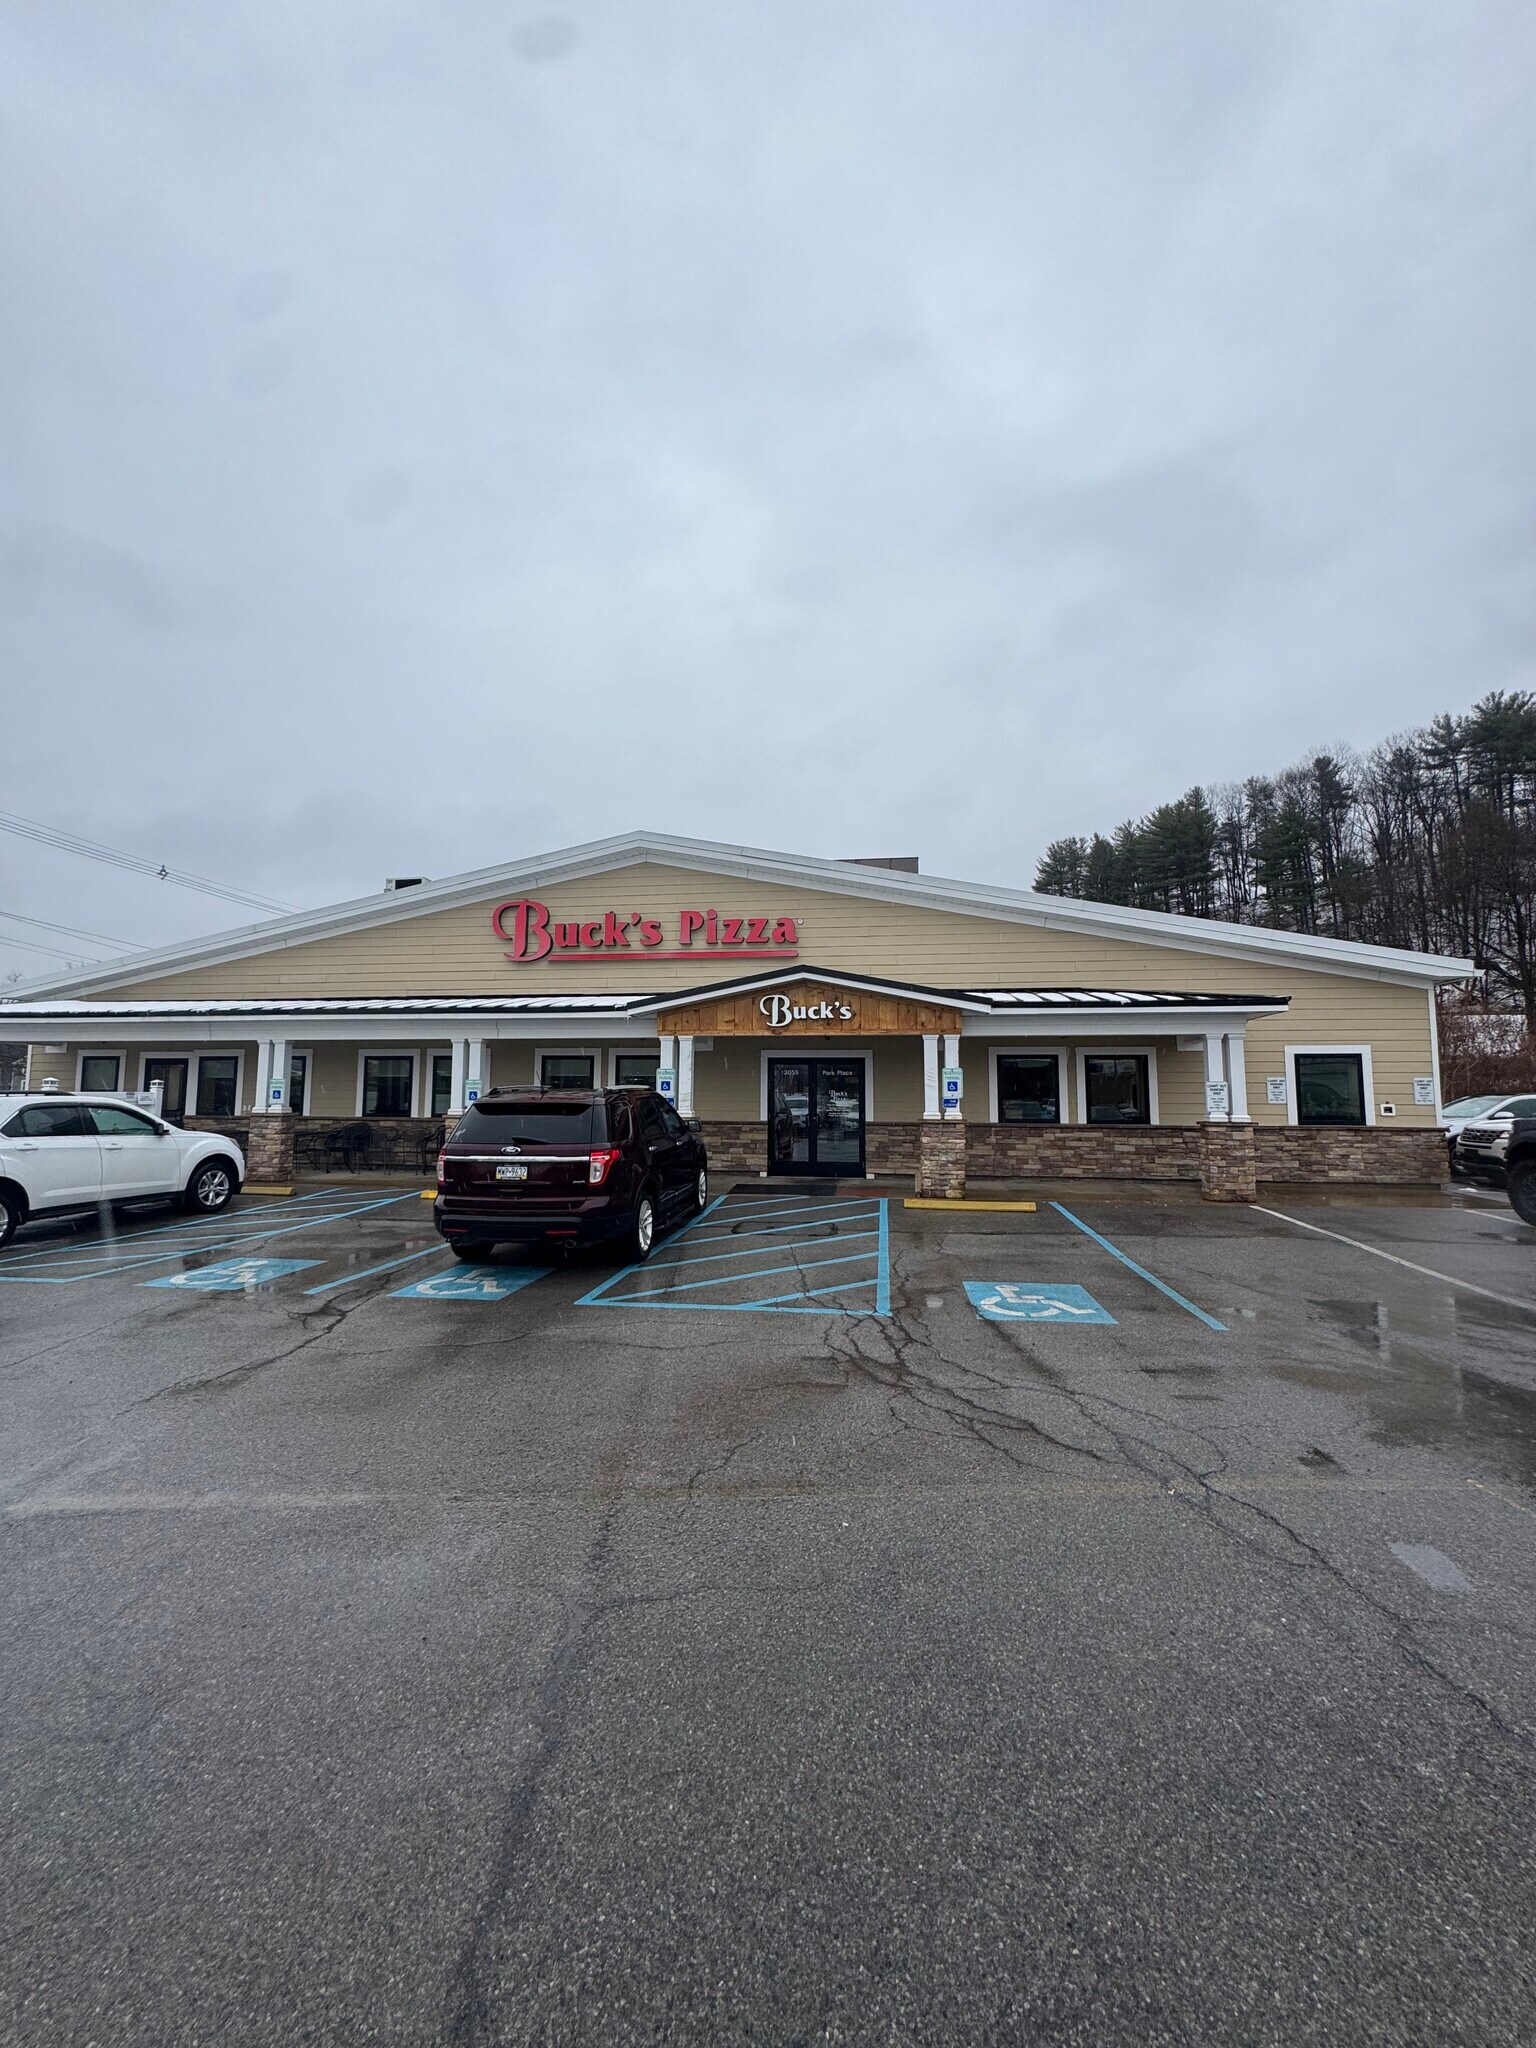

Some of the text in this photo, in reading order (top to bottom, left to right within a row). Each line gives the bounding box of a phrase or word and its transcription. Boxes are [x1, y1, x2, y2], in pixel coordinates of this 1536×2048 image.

[492, 899, 800, 962] Buck's Pizza
[760, 994, 853, 1028] Buck's
